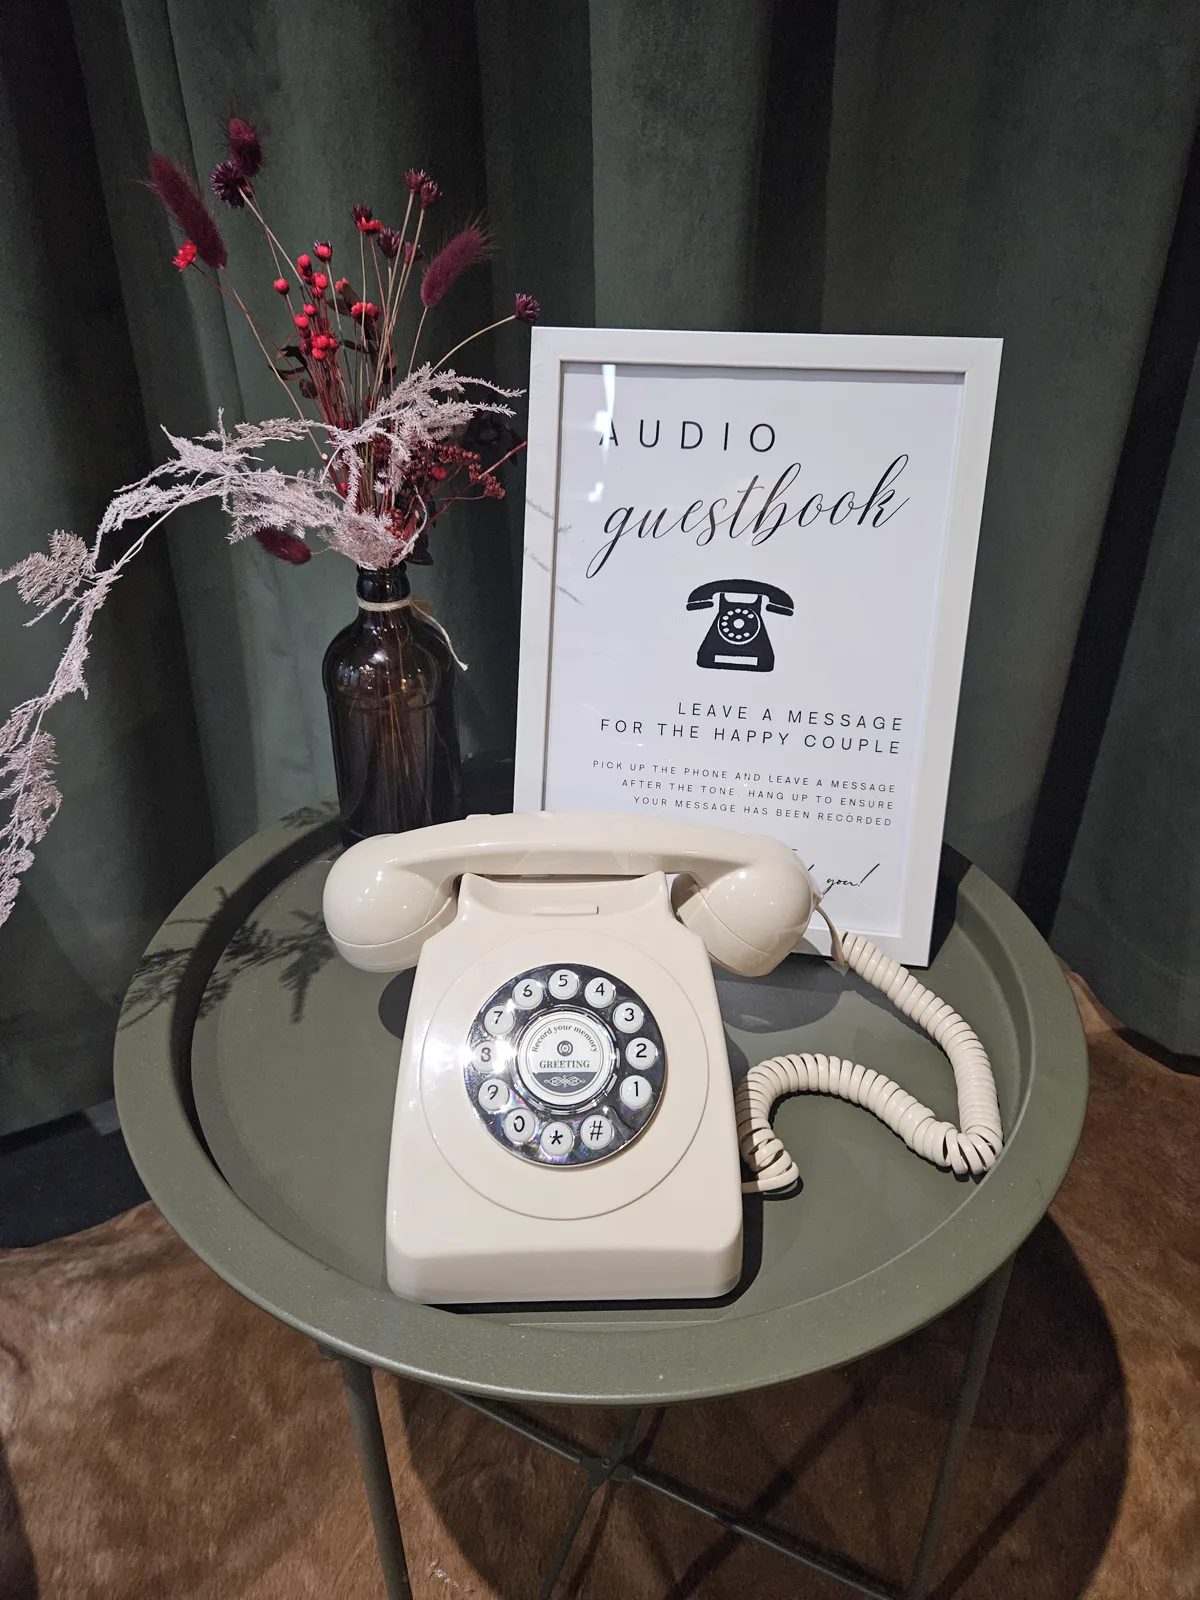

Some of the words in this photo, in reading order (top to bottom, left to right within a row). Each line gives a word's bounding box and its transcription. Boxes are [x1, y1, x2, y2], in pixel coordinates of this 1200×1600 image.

[599, 420, 775, 452] AUDIO
[585, 453, 911, 579] guestbook
[678, 701, 747, 719] LEAVE
[761, 708, 771, 721] A
[788, 709, 902, 730] MESSAGE
[600, 718, 642, 733] FOR
[657, 722, 699, 738] THE
[714, 727, 788, 745] HAPPY
[804, 734, 899, 754] COUPLE
[592, 760, 622, 769] PICK
[629, 763, 645, 771] UP
[652, 764, 675, 774] THE
[684, 767, 726, 778] PHONE
[734, 772, 760, 781] AND
[768, 775, 808, 785] LEAVE
[830, 779, 894, 792] MESSAGE
[621, 779, 661, 789] AFTER
[669, 782, 692, 792] THE
[748, 790, 783, 799] HANG
[791, 793, 807, 801] UP
[815, 795, 832, 804] TO
[840, 797, 892, 809] ENSURE
[633, 795, 666, 805] YOUR
[674, 799, 735, 812] MESSAGE
[743, 806, 767, 815] HAS
[776, 808, 809, 818] BEEN
[817, 812, 891, 825] RECORDED
[558, 974, 567, 987] 5
[595, 982, 605, 997] 4
[522, 984, 532, 997] 6
[493, 1010, 503, 1024] 7
[624, 1007, 634, 1021] 3
[531, 1028, 553, 1053] Record
[553, 1025, 572, 1034] your
[574, 1027, 599, 1053] memory
[480, 1046, 491, 1062] 8
[635, 1042, 647, 1058] 2
[539, 1059, 589, 1068] GREETING
[487, 1084, 498, 1100] 9
[589, 1120, 603, 1140] #
